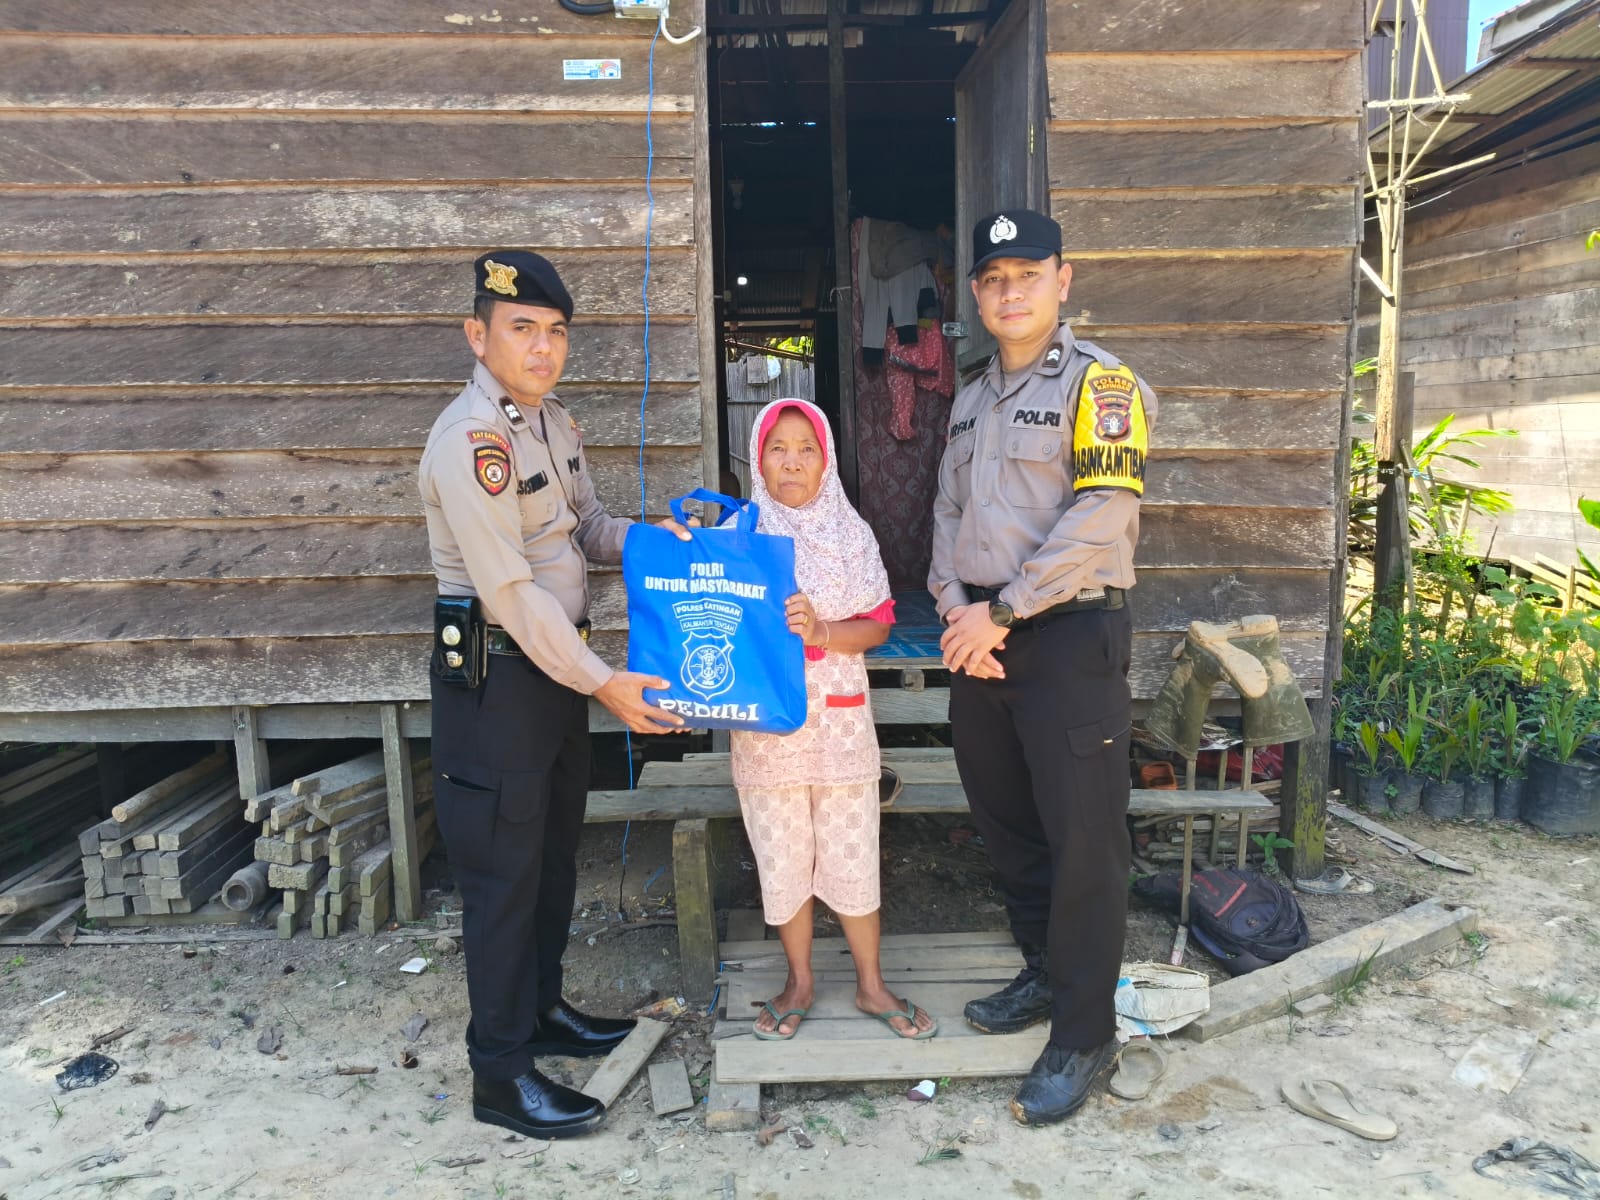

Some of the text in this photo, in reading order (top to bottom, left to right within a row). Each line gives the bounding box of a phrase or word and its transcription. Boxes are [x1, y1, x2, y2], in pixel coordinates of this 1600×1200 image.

[1093, 376, 1132, 389] POLRES
[1013, 409, 1061, 427] POLRI
[690, 562, 724, 577] POLRI
[645, 576, 767, 600] UNTUK MASYARAKAT
[704, 602, 740, 617] KATINGAN
[657, 698, 760, 721] PEDULI
